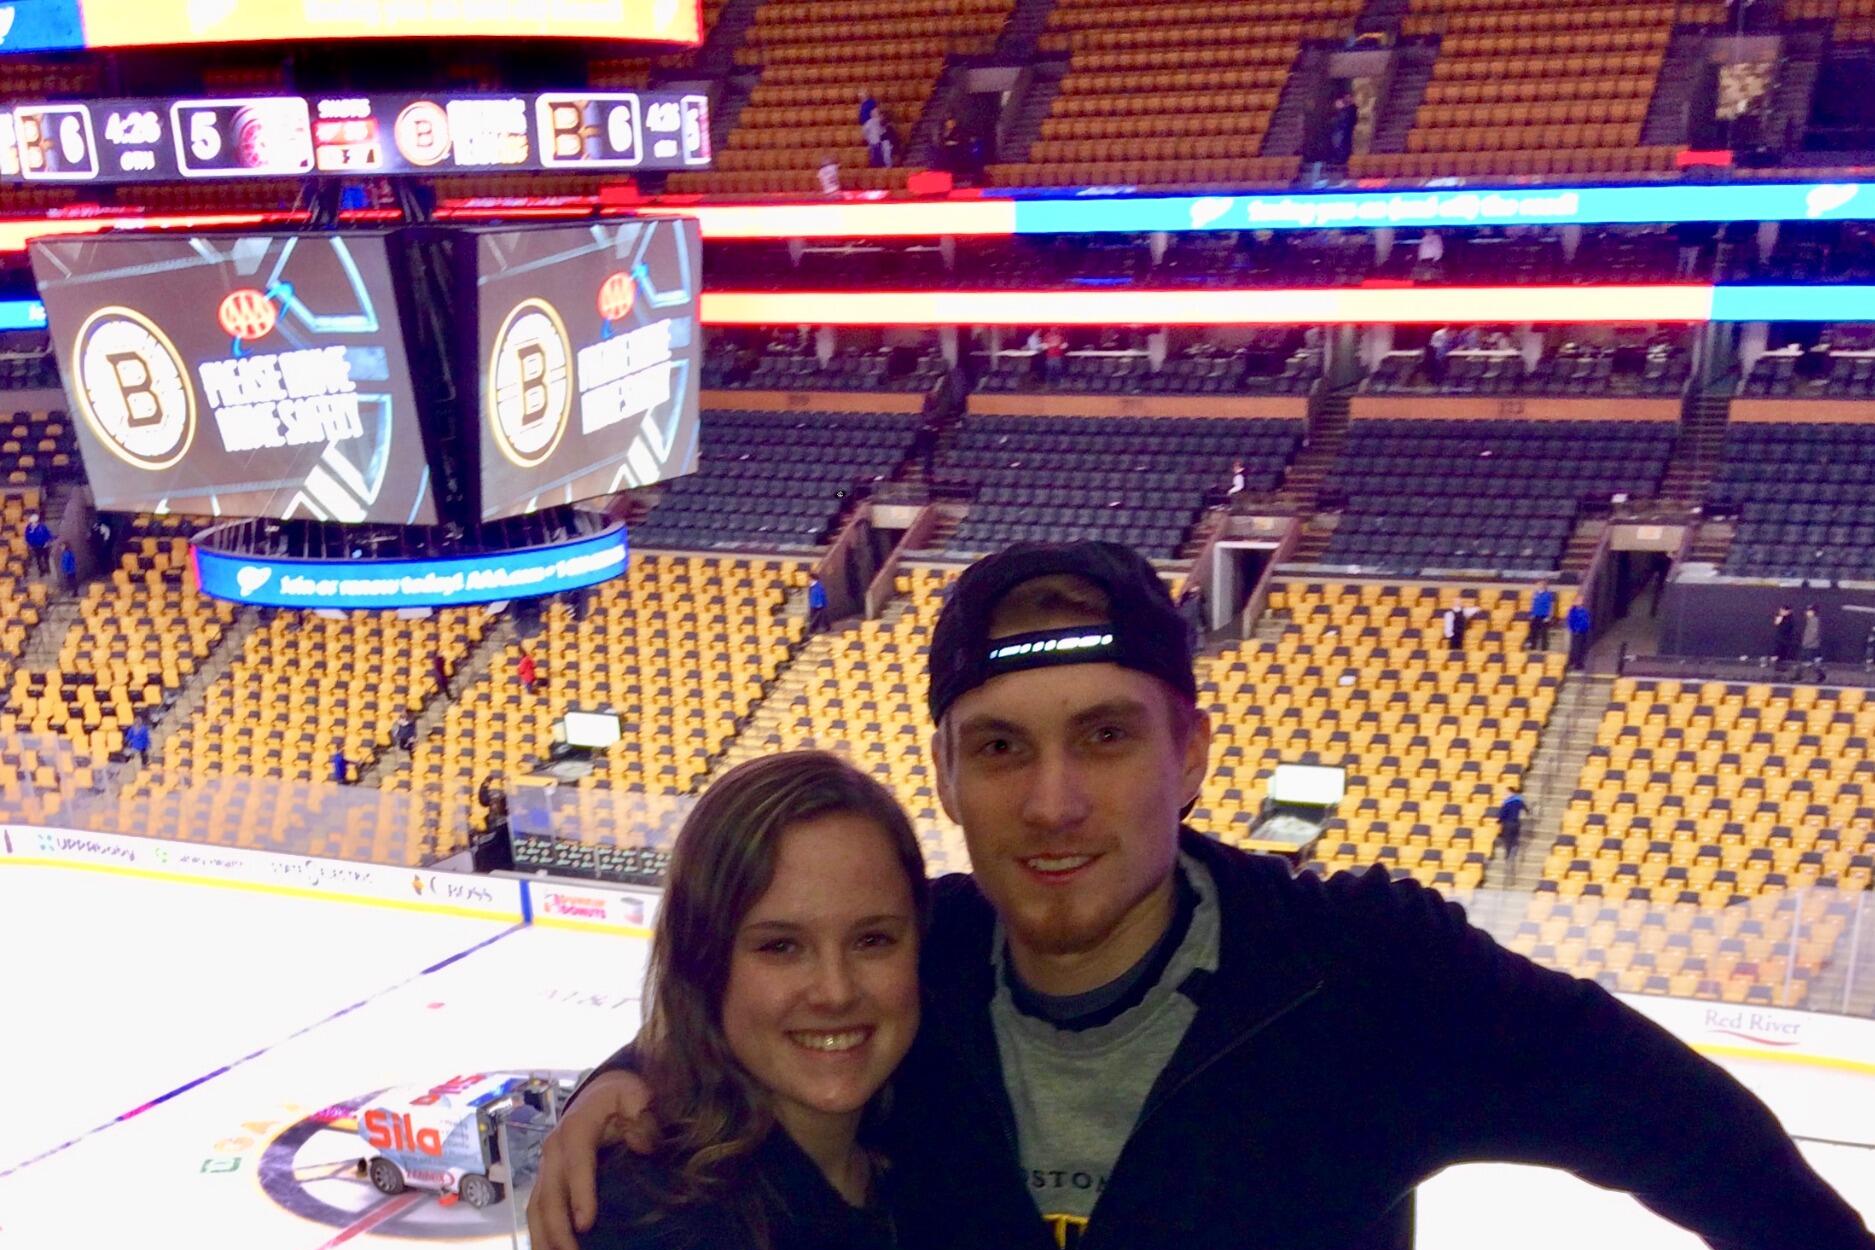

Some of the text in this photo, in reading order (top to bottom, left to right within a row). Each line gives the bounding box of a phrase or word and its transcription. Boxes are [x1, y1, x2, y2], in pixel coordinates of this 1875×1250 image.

[190, 111, 221, 160] 5
[105, 351, 164, 428] B
[516, 343, 549, 427] B
[1705, 1009, 1800, 1035] Red River
[364, 1109, 442, 1157] Sila
